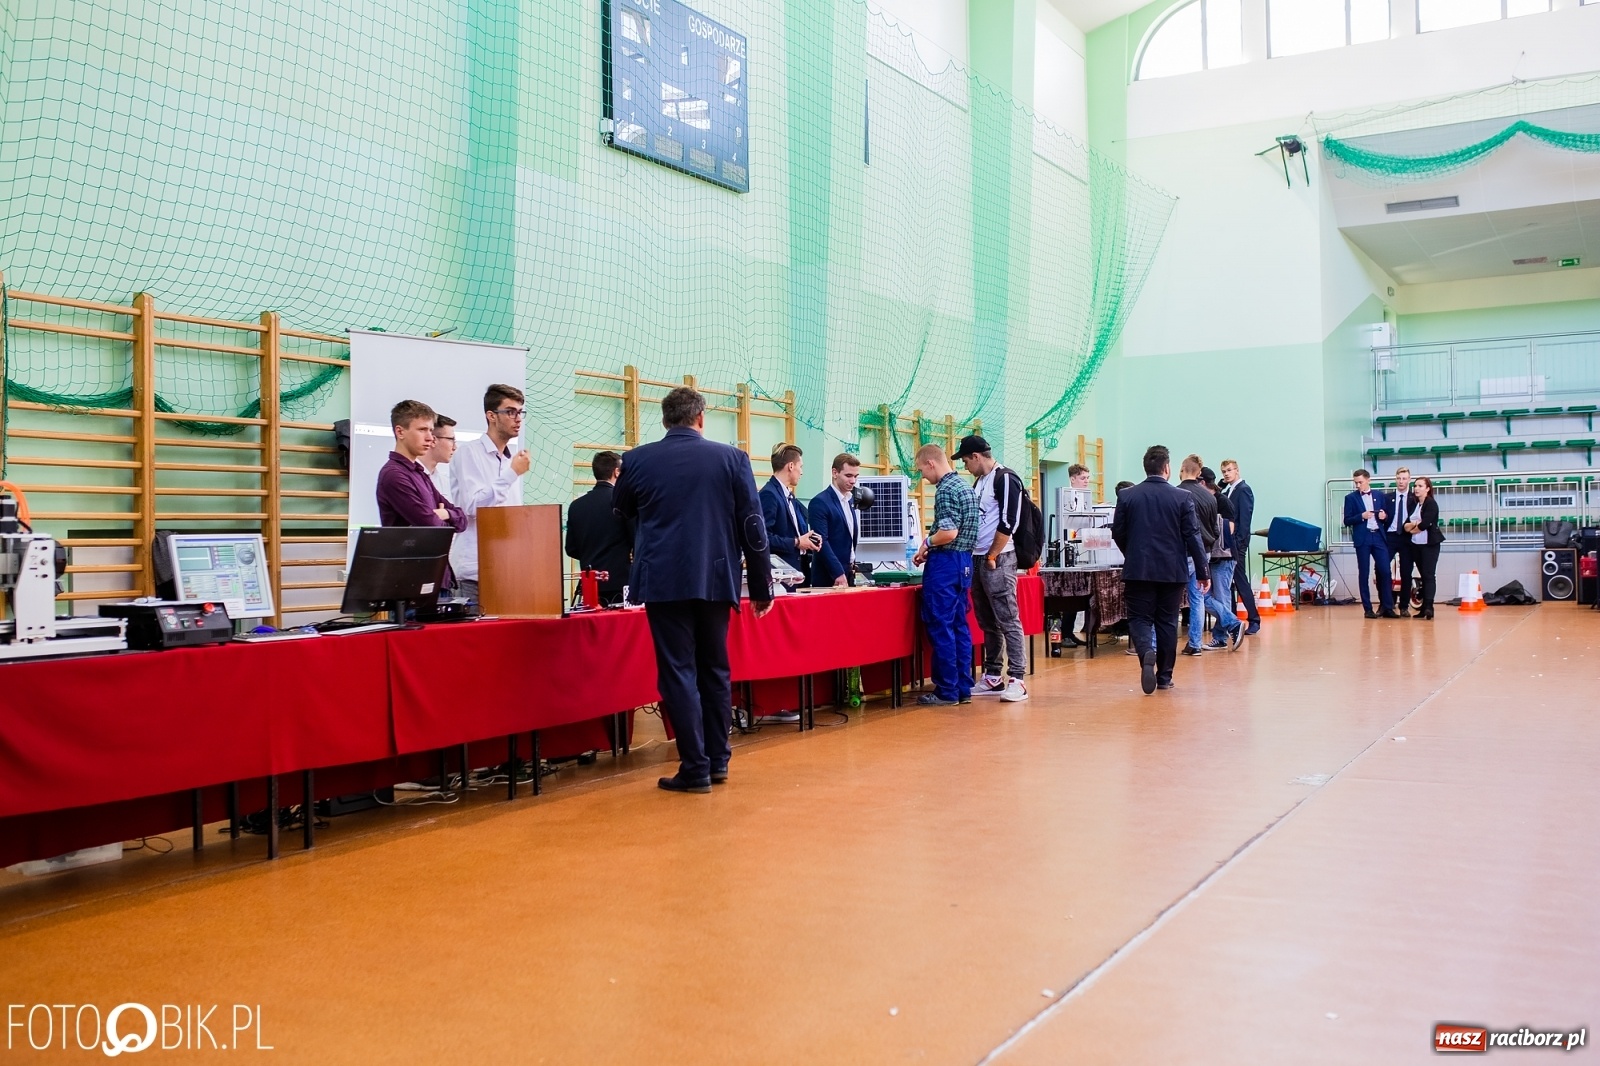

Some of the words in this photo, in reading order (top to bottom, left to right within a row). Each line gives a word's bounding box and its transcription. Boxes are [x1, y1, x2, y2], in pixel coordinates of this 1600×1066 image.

[688, 14, 746, 59] GOSPODARZE
[667, 125, 673, 137] 2
[701, 139, 706, 150] 3
[731, 152, 737, 162] 4
